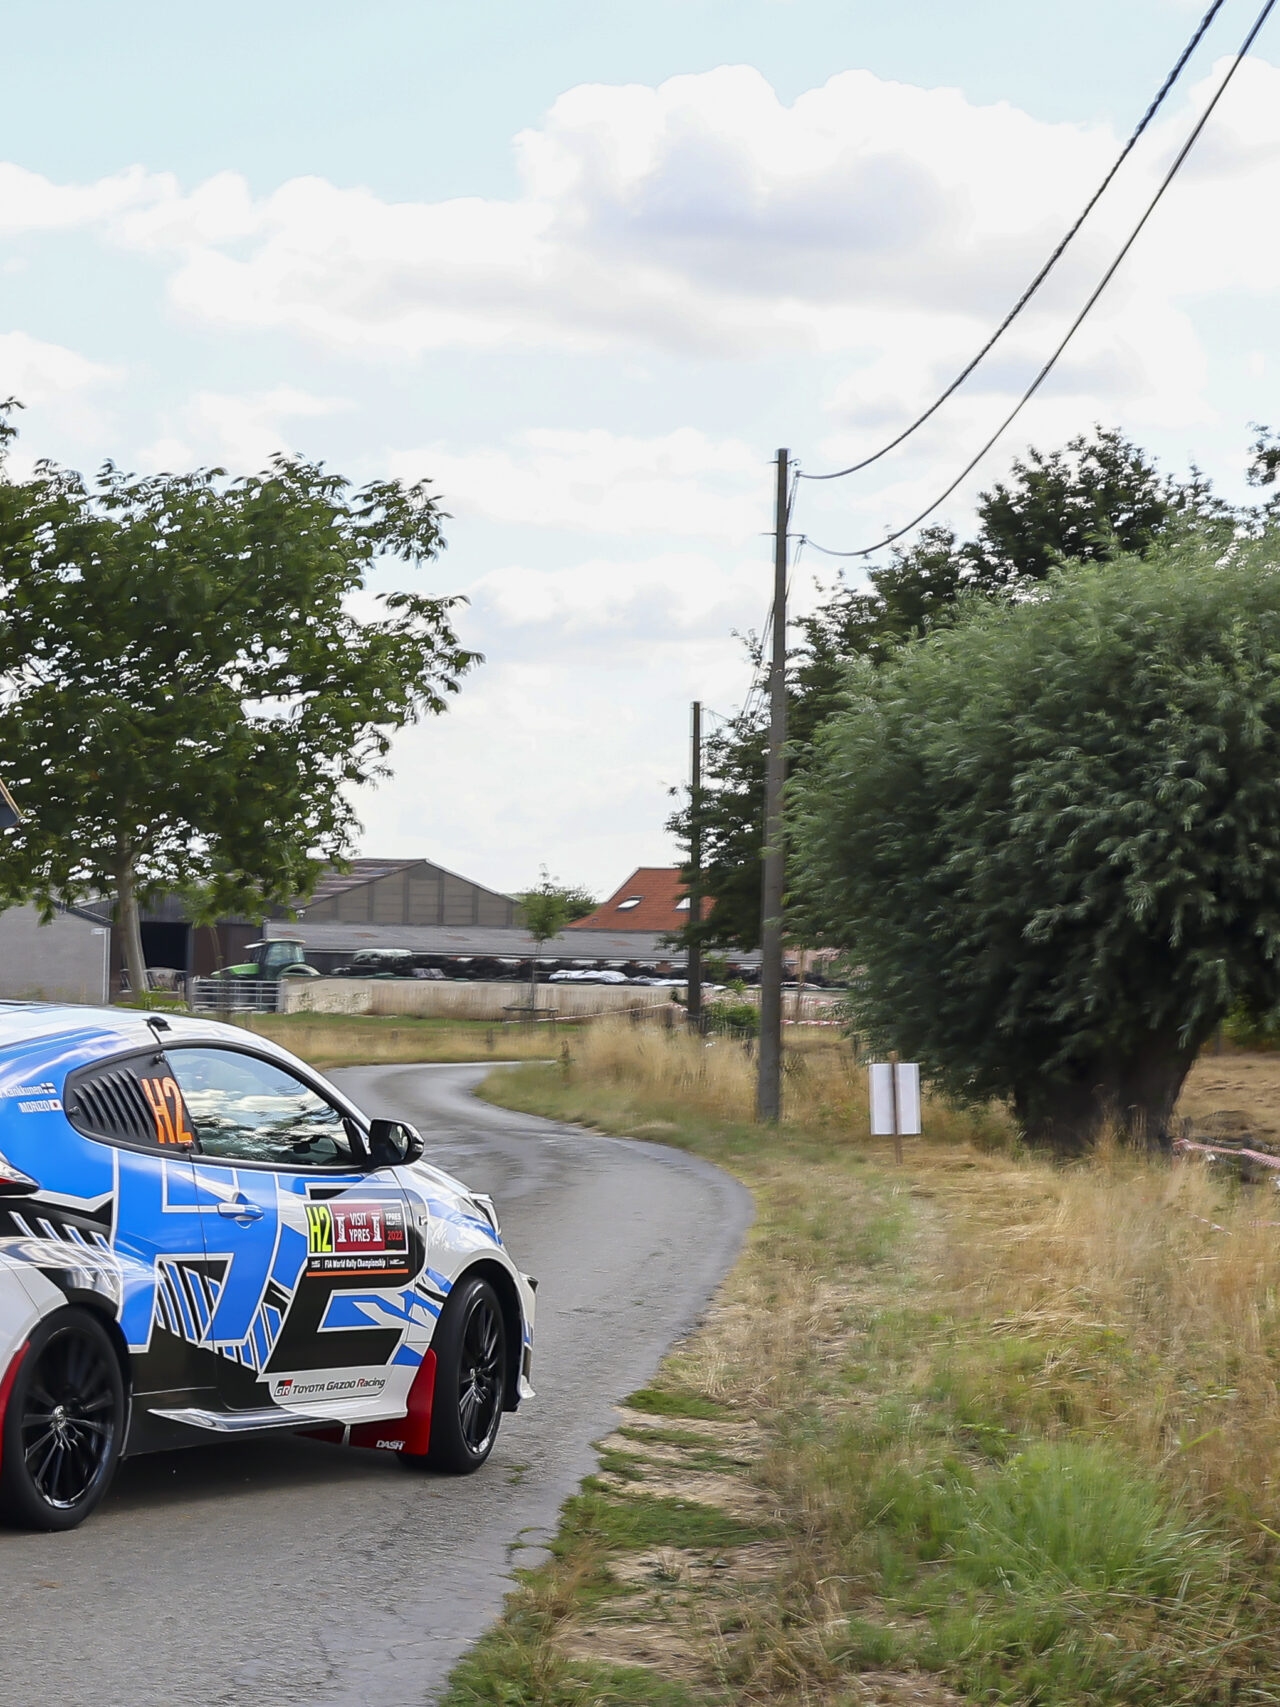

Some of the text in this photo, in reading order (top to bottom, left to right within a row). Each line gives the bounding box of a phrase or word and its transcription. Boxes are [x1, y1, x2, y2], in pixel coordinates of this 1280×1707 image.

[141, 1076, 193, 1144] H2
[349, 1212, 367, 1226] VISIT
[306, 1206, 332, 1252] H2
[349, 1228, 370, 1242] YPRES
[387, 1230, 403, 1241] 2022
[333, 1259, 346, 1268] World
[357, 1258, 386, 1269] Championship
[293, 1383, 325, 1395] TOYOTA
[326, 1380, 356, 1391] GAZOO
[356, 1378, 386, 1389] Racing
[376, 1440, 405, 1450] DASH
